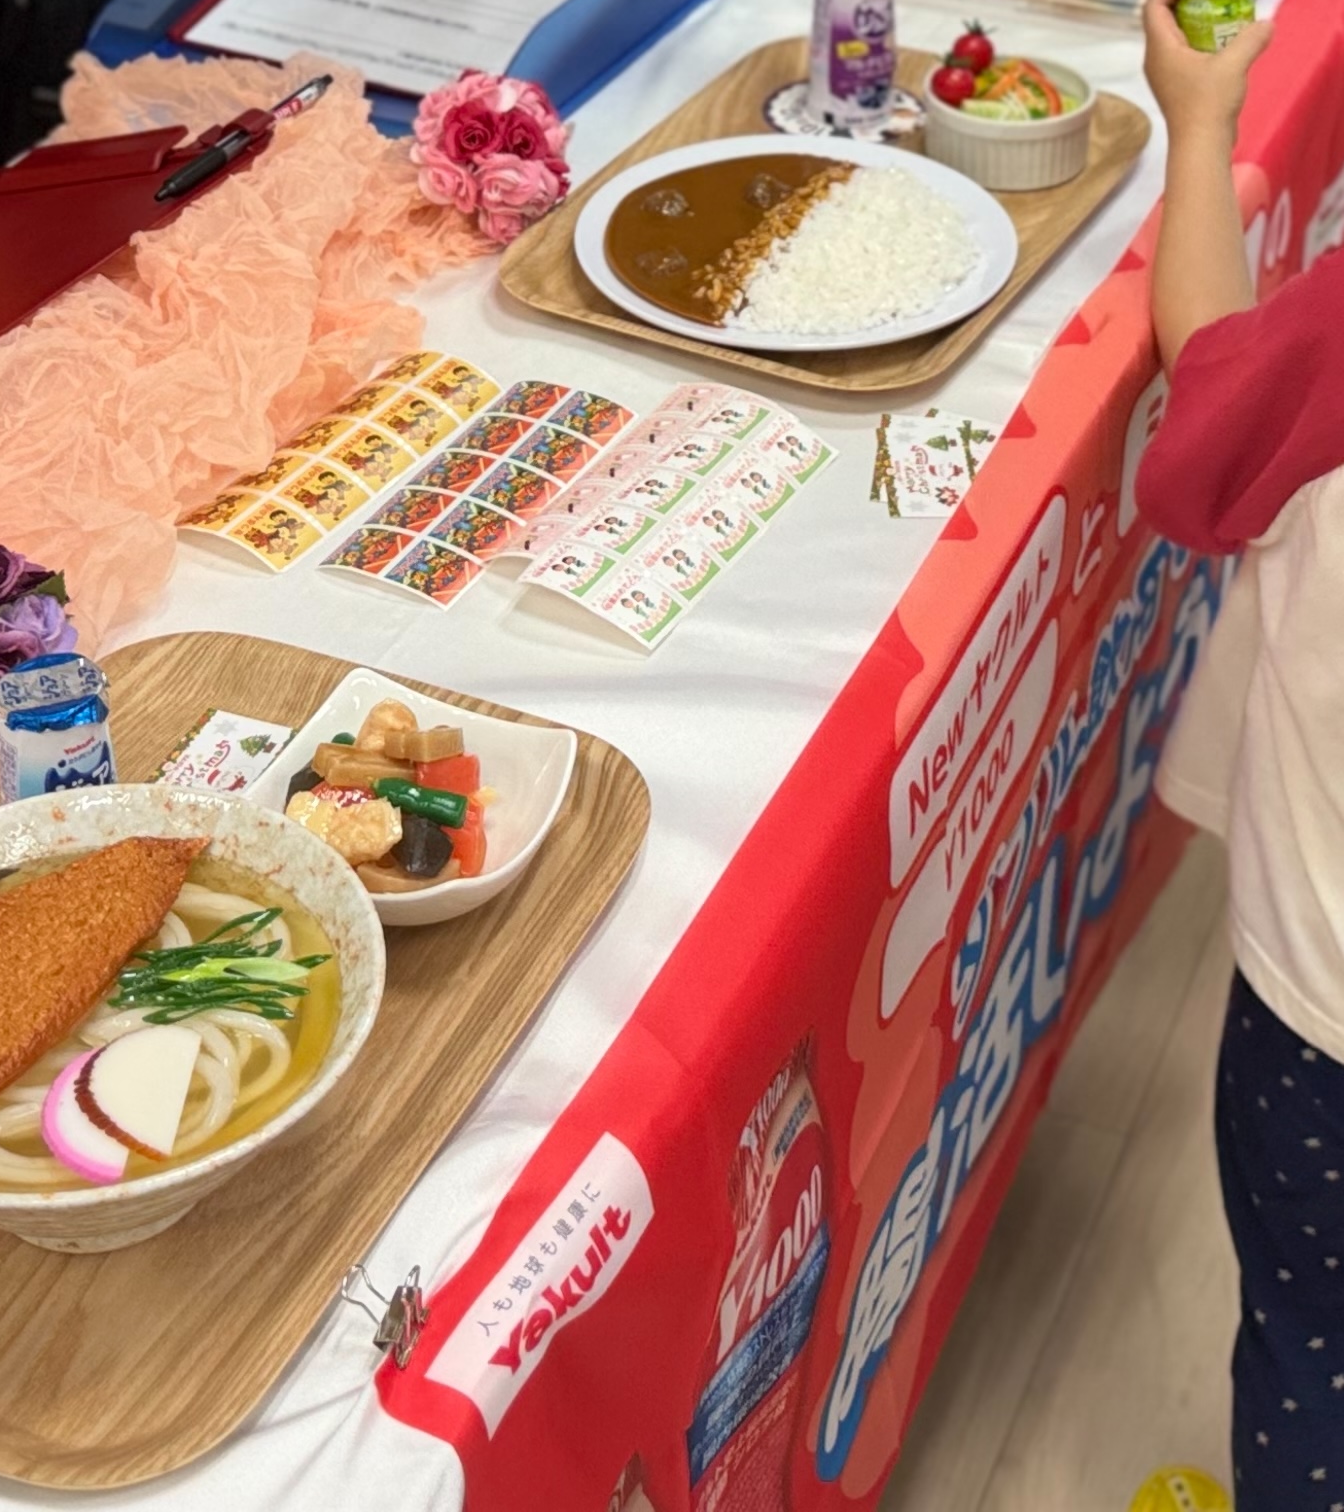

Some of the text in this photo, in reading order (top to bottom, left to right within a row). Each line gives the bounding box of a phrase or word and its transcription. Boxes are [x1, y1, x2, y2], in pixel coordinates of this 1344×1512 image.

[943, 719, 1016, 891] Y1000
[952, 541, 1188, 1044] ダブル飲み
[473, 1177, 606, 1339] 人も地球も健康に
[486, 1197, 644, 1384] Yakult
[717, 1168, 824, 1365] Y1000
